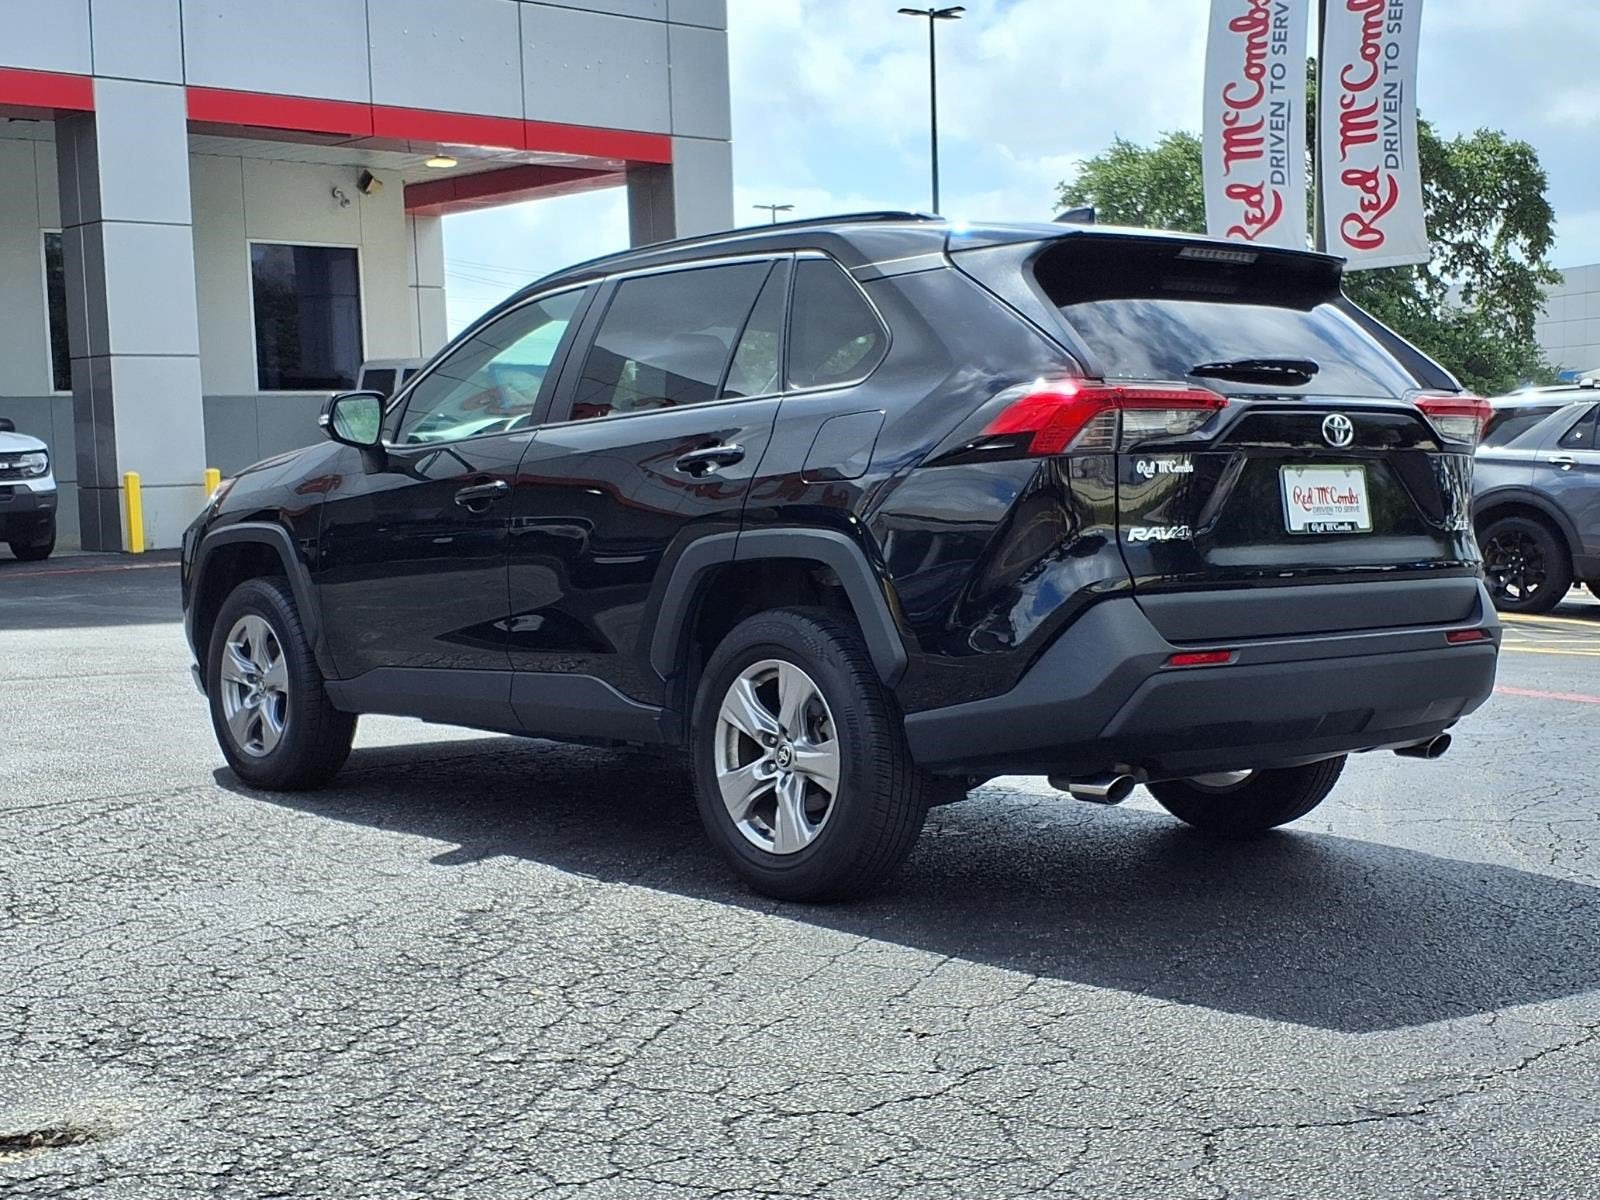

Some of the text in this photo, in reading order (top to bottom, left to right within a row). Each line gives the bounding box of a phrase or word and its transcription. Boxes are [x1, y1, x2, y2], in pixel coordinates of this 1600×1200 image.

[1384, 41, 1401, 75] TO
[1270, 1, 1290, 186] DRIVEN TO SERV
[1384, 82, 1399, 170] DRIVEN
[1340, 165, 1399, 250] Red
[1136, 460, 1155, 478] Red
[1293, 486, 1359, 512] Red McCombs
[1127, 525, 1191, 542] RAV4
